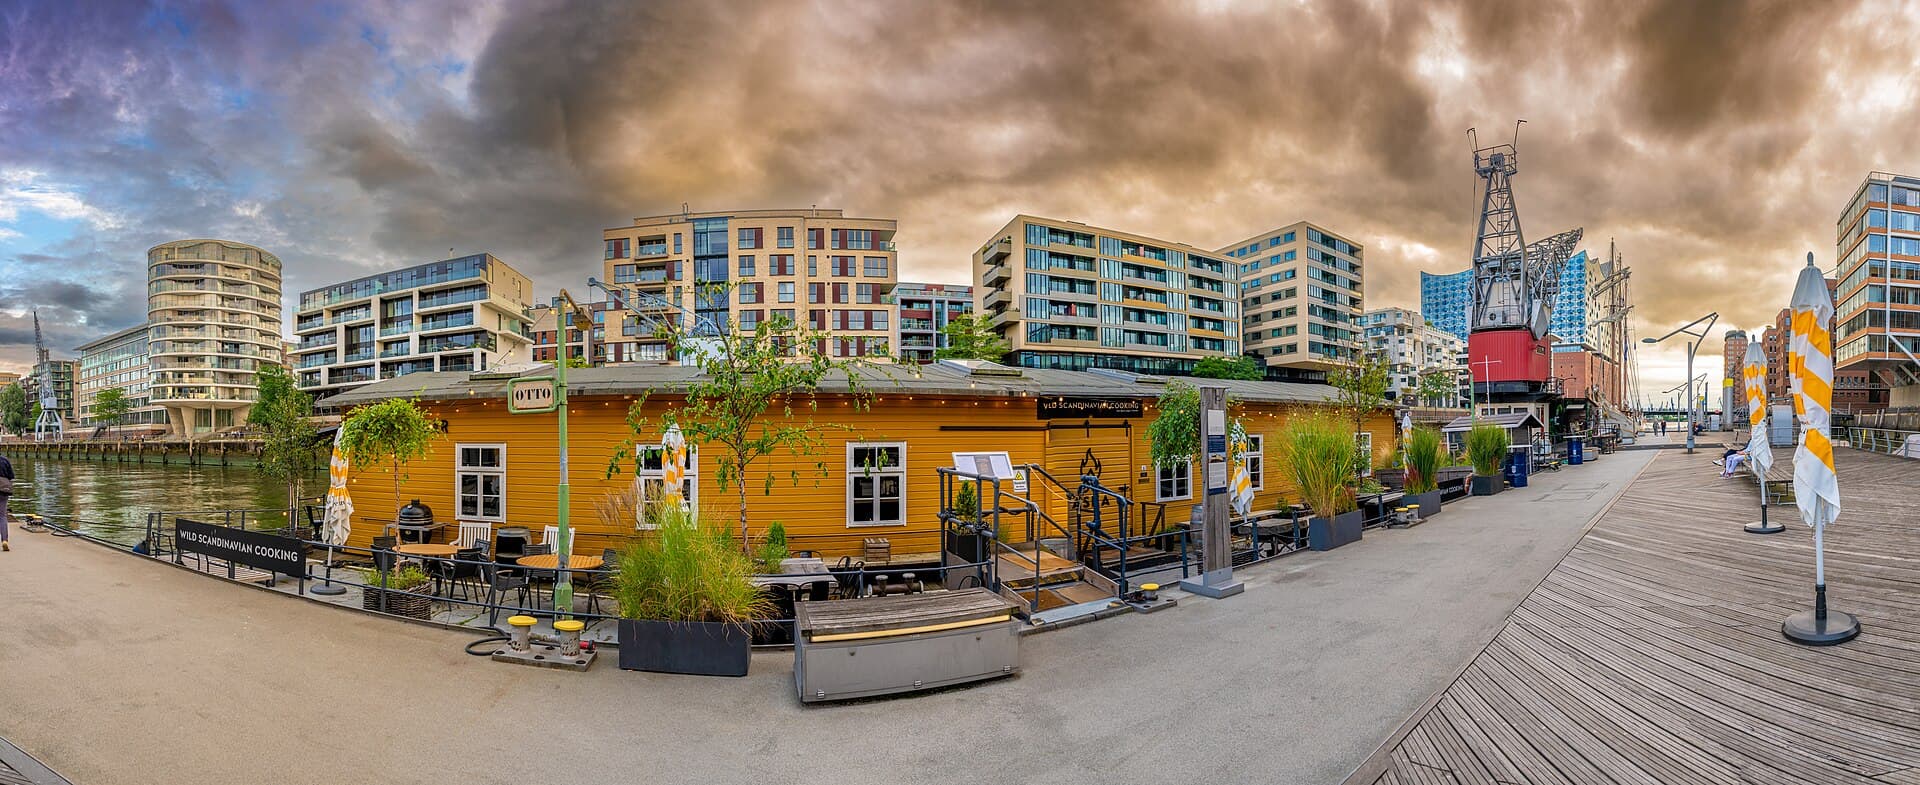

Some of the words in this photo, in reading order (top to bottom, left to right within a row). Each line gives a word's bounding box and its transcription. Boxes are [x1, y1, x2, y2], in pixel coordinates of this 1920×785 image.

[515, 388, 551, 401] OTTO
[180, 529, 197, 542] WILD
[198, 533, 254, 554] SCANDINAVIAN
[255, 545, 298, 561] COOKING
